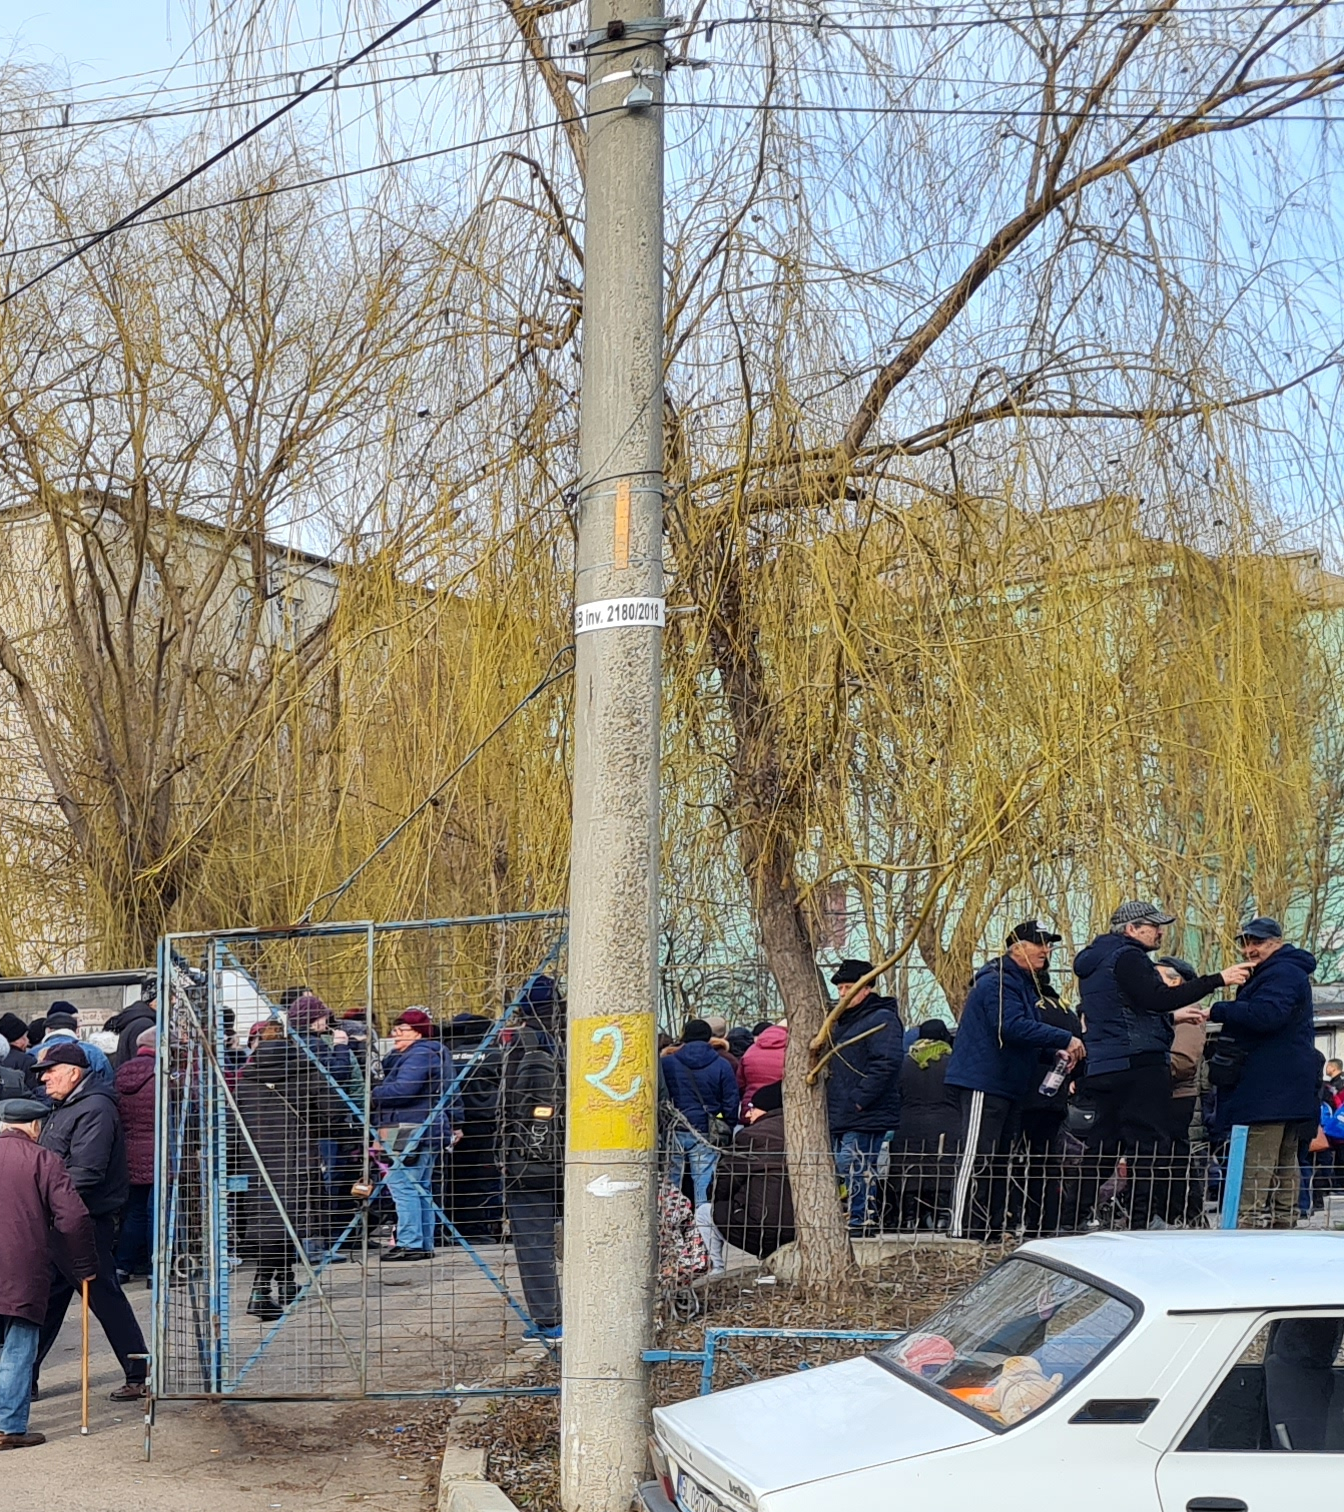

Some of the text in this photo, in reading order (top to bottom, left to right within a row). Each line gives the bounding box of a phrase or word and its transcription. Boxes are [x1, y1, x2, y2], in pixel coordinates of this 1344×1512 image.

[585, 608, 604, 627] inv.
[607, 602, 659, 622] 2180/2018
[585, 1025, 642, 1101] 2
